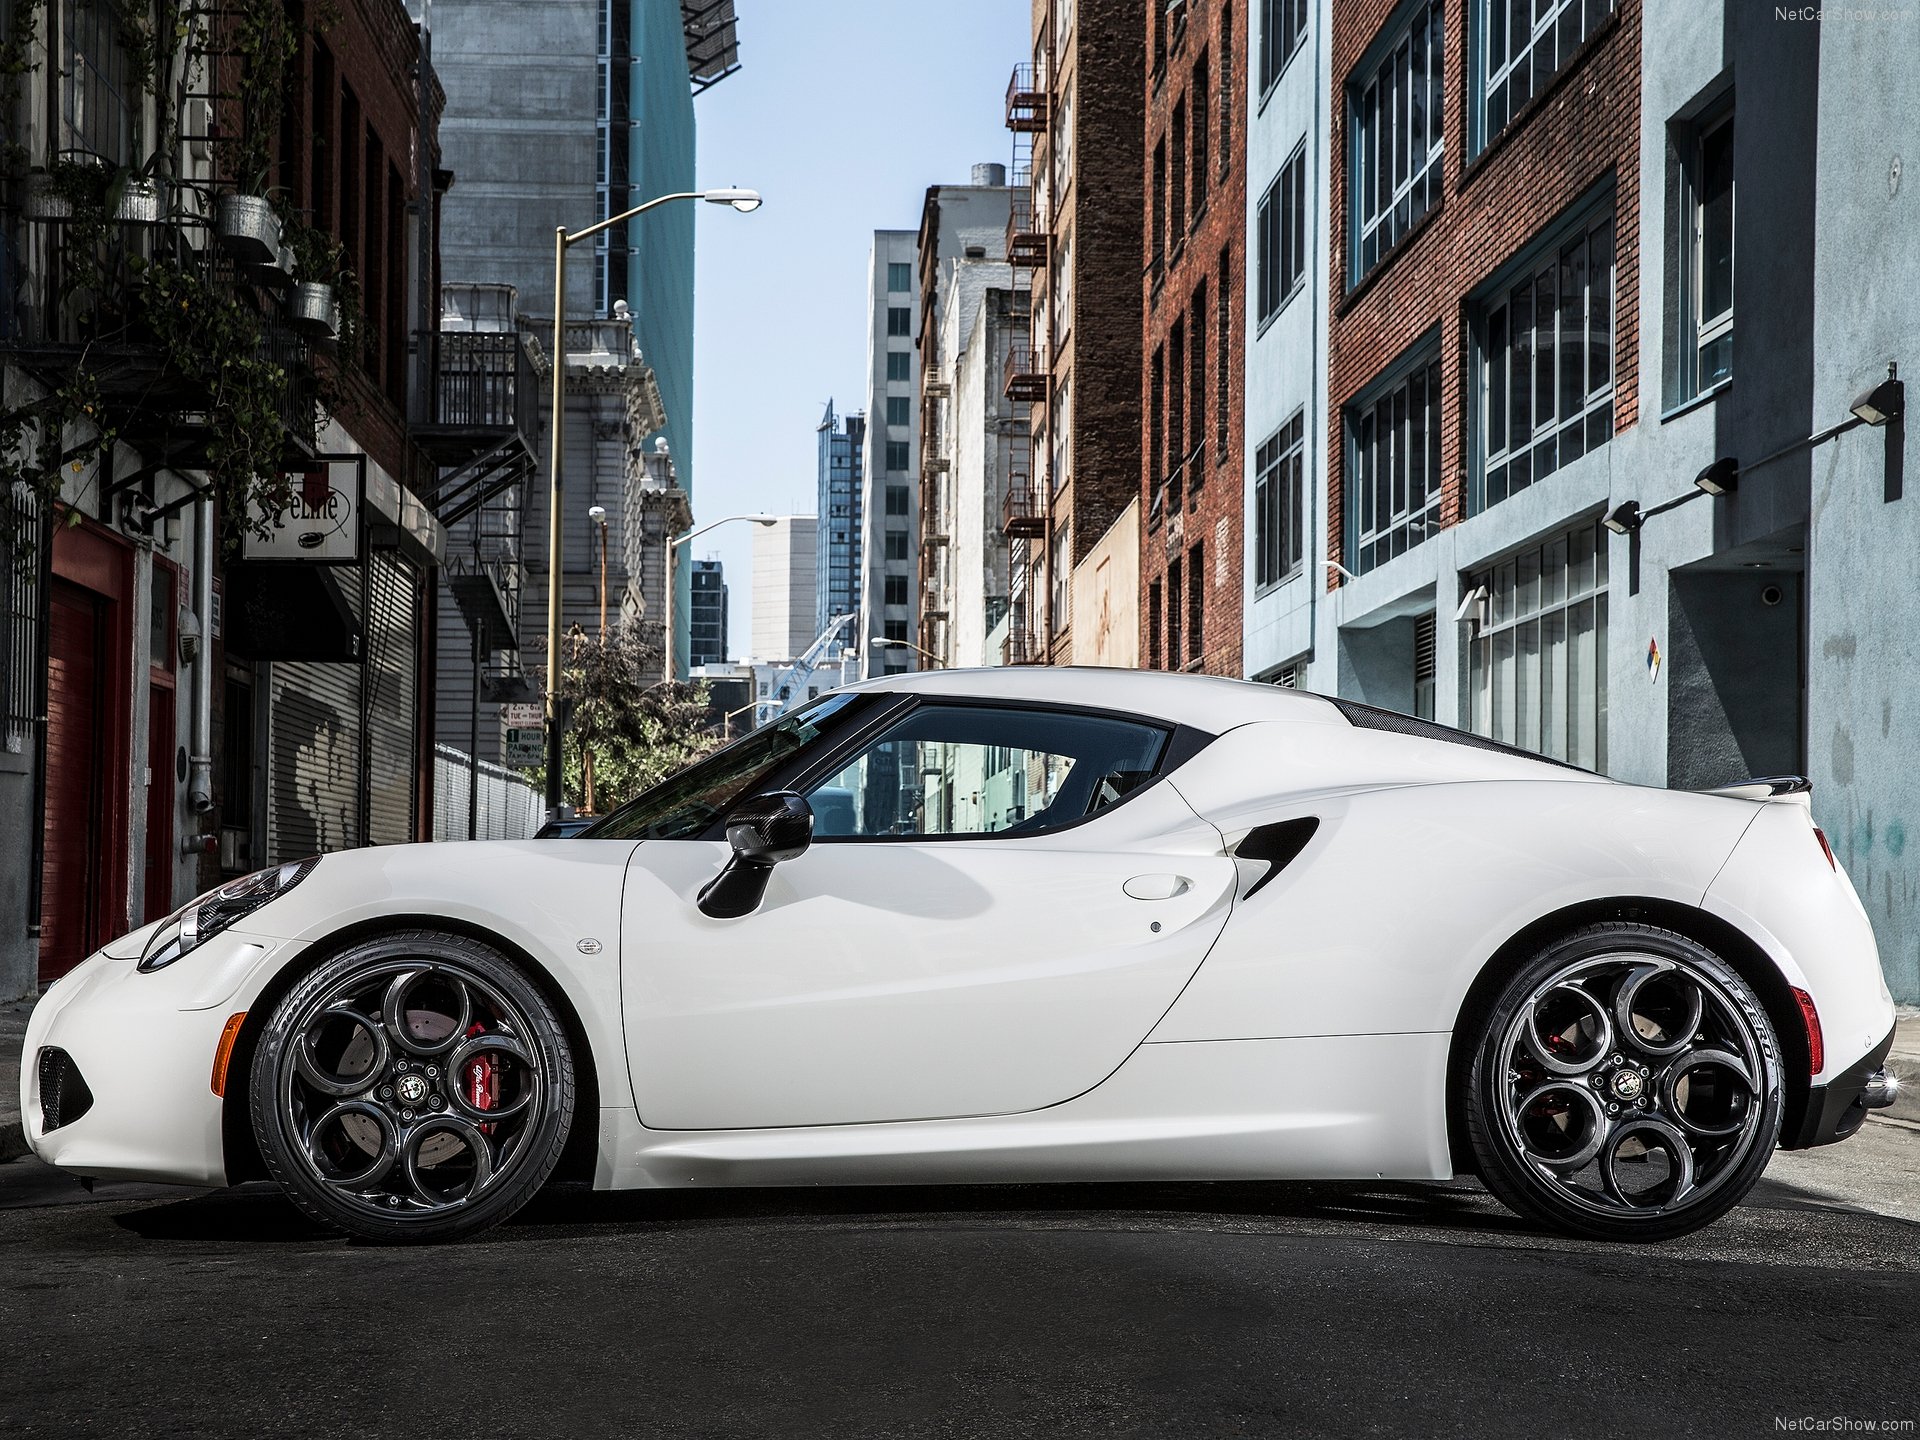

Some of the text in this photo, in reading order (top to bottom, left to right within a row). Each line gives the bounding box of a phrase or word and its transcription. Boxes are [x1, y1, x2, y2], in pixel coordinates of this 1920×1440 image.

[521, 732, 541, 740] HOUR
[508, 743, 543, 752] PARING
[1736, 997, 1775, 1059] ZERO
